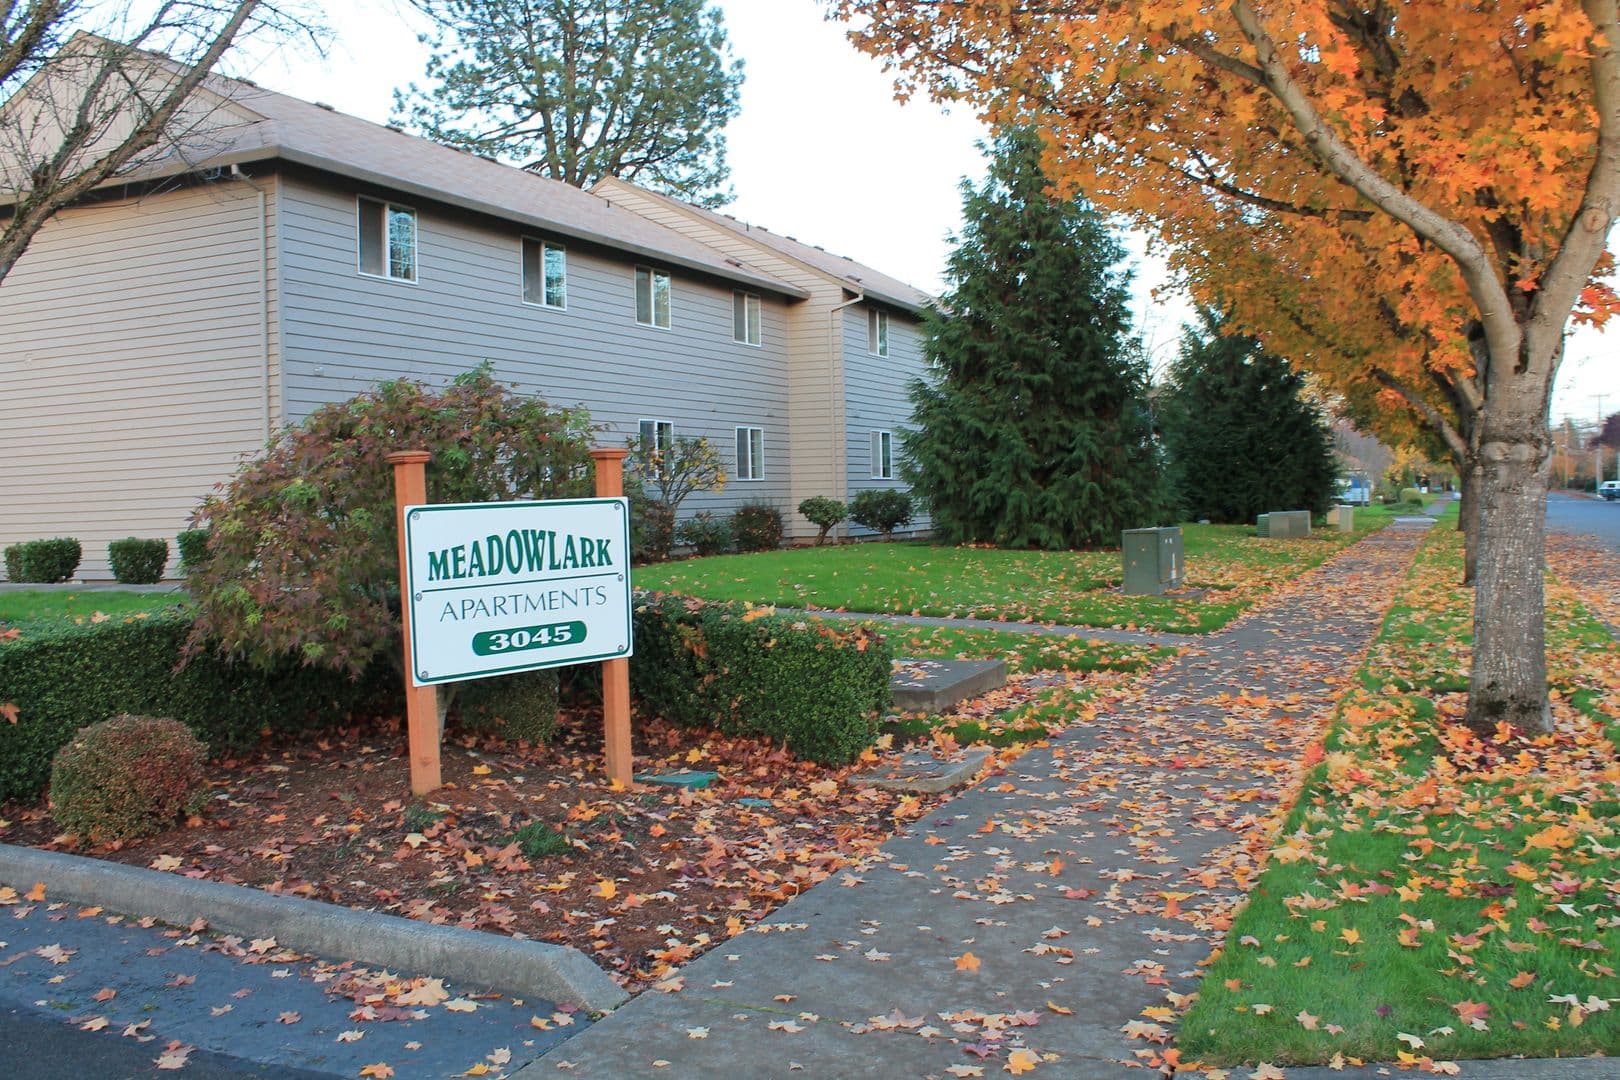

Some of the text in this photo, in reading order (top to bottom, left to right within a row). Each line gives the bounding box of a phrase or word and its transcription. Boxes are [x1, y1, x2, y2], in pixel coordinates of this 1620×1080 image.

[428, 529, 613, 581] MEADOWLARK
[439, 585, 607, 622] APARTMENTS
[489, 625, 572, 651] 3045
